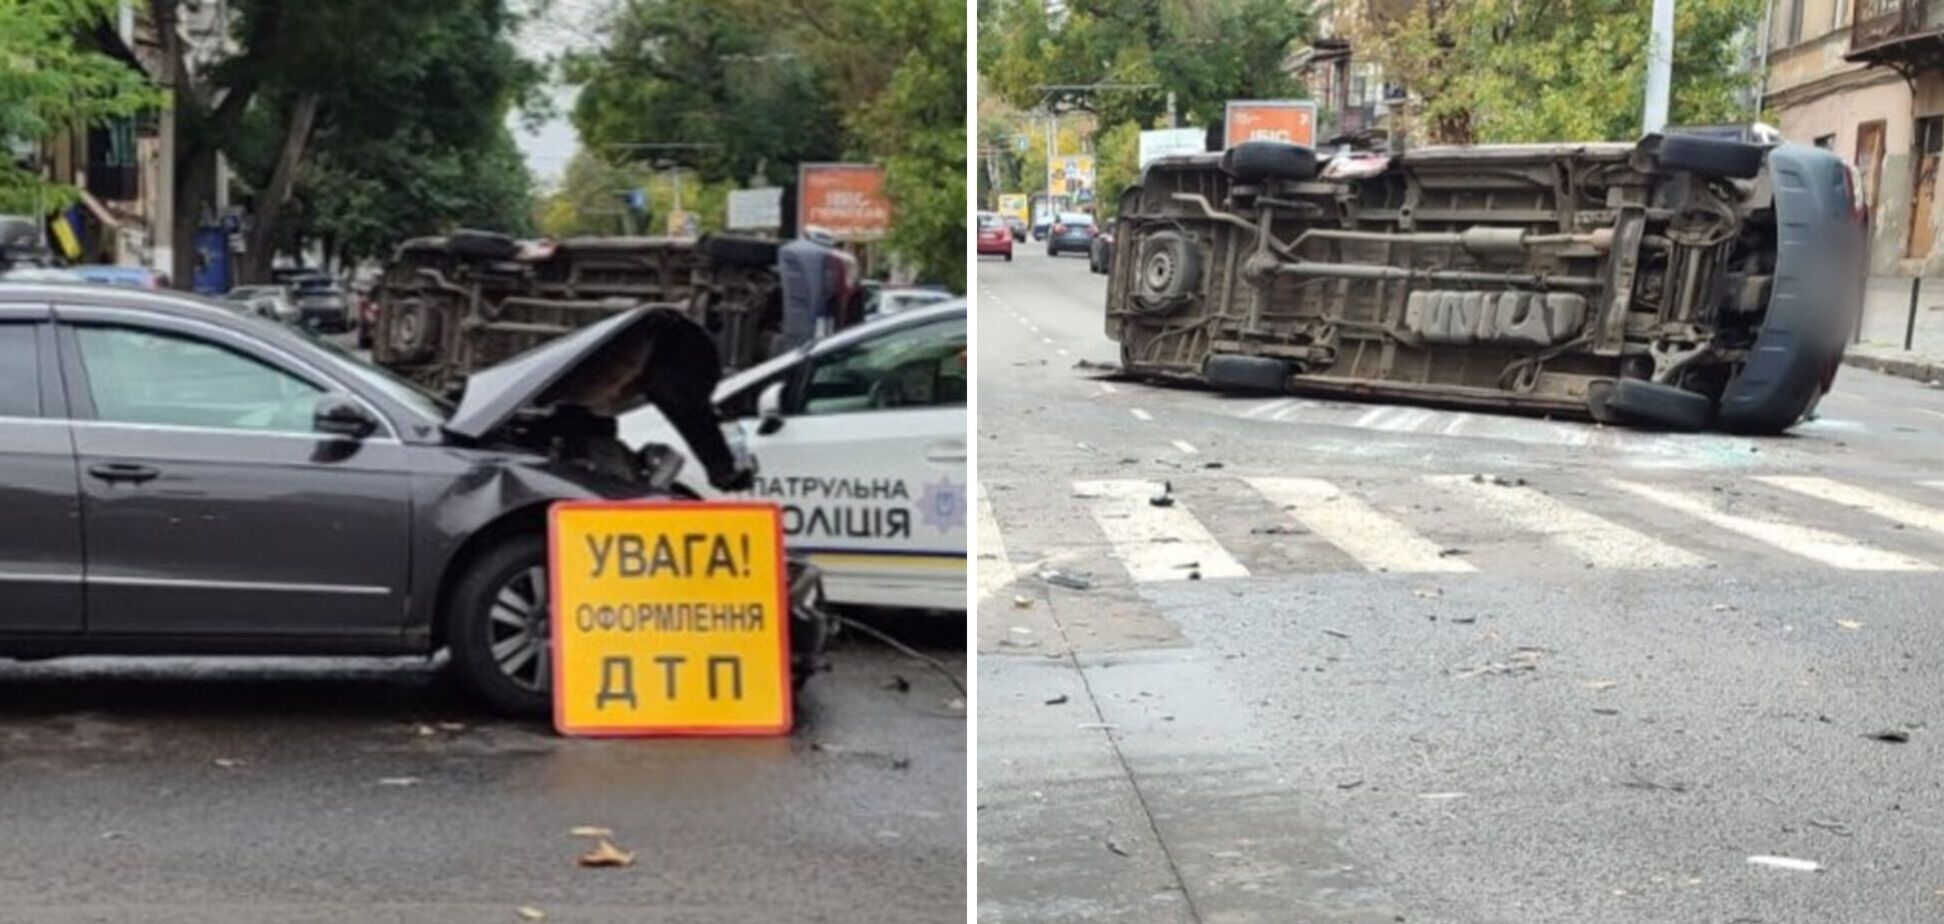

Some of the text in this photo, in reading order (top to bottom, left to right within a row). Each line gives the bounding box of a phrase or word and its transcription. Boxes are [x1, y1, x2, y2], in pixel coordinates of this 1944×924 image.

[751, 477, 909, 499] ПАТРУЛЬНА
[781, 505, 911, 538] ОЛІЦІЯ
[585, 533, 751, 578] УВАГА!
[575, 602, 764, 633] ОФОРМЛЕННЯ
